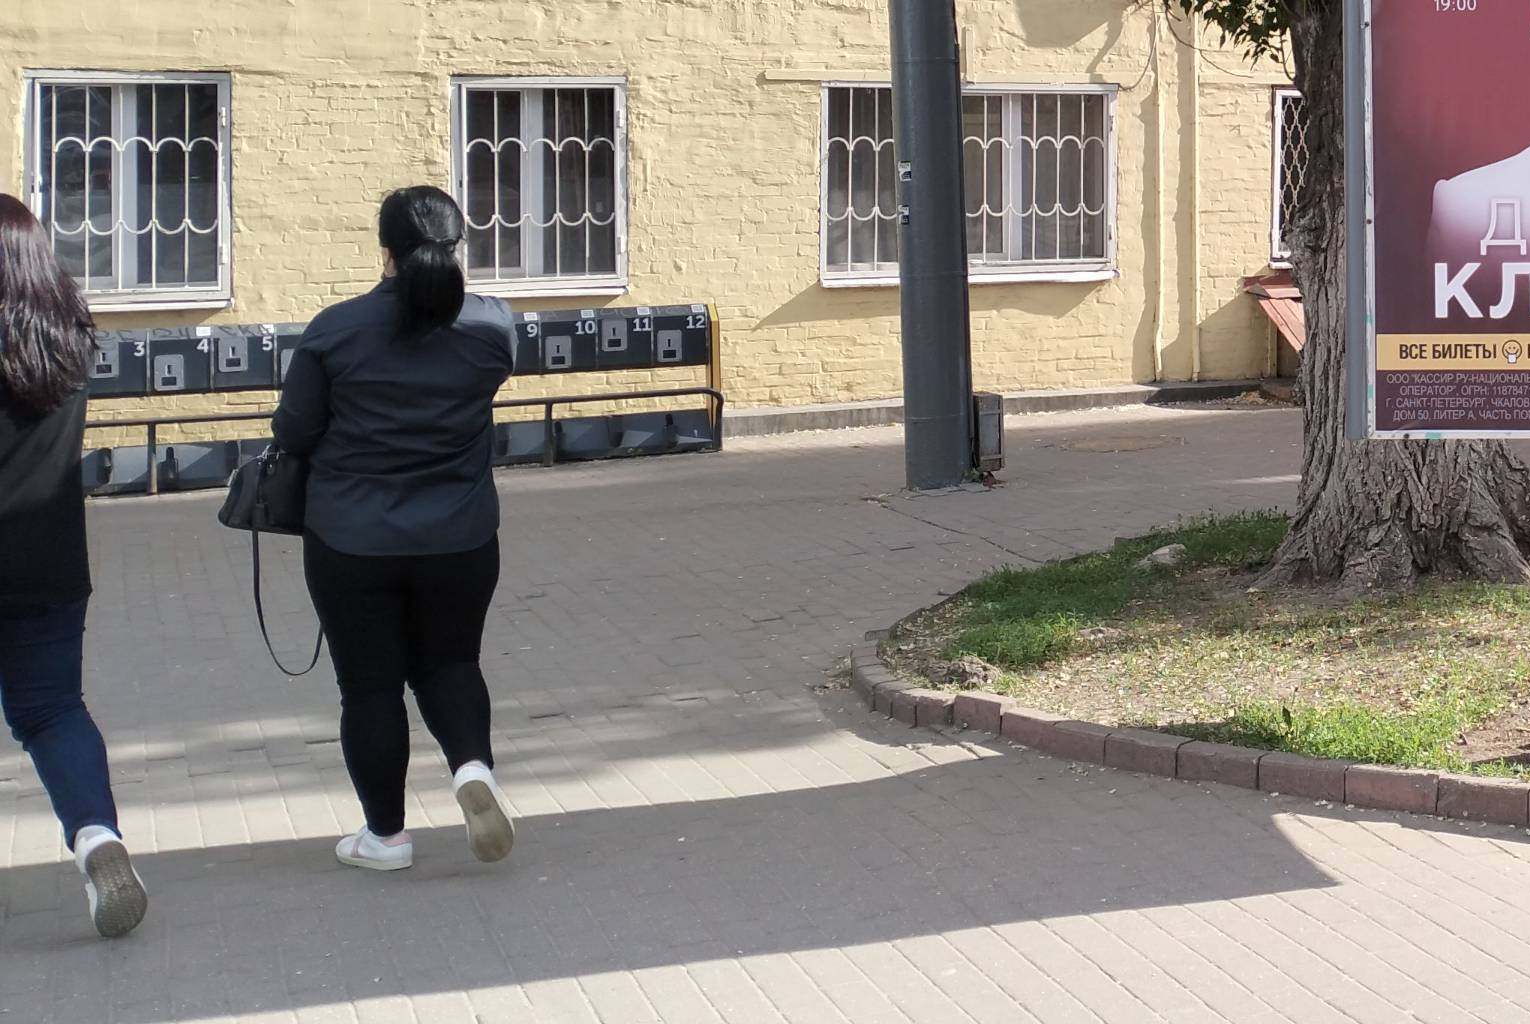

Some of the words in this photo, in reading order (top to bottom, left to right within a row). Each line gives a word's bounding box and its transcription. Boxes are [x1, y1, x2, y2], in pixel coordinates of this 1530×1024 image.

[575, 320, 596, 335] 10
[632, 317, 652, 332] 11
[685, 314, 706, 329] 12
[526, 323, 539, 338] 9
[133, 341, 146, 357] 3
[196, 338, 210, 353] 4
[261, 336, 274, 351] 5
[1399, 343, 1428, 359] ВСЕ
[1432, 343, 1497, 360] БИЛЕТЫ
[1386, 373, 1409, 384] ООО
[1393, 410, 1415, 421] ДОМ
[1434, 410, 1466, 420] ЛИТЕР
[1479, 410, 1511, 420] ЧАСТЬ
